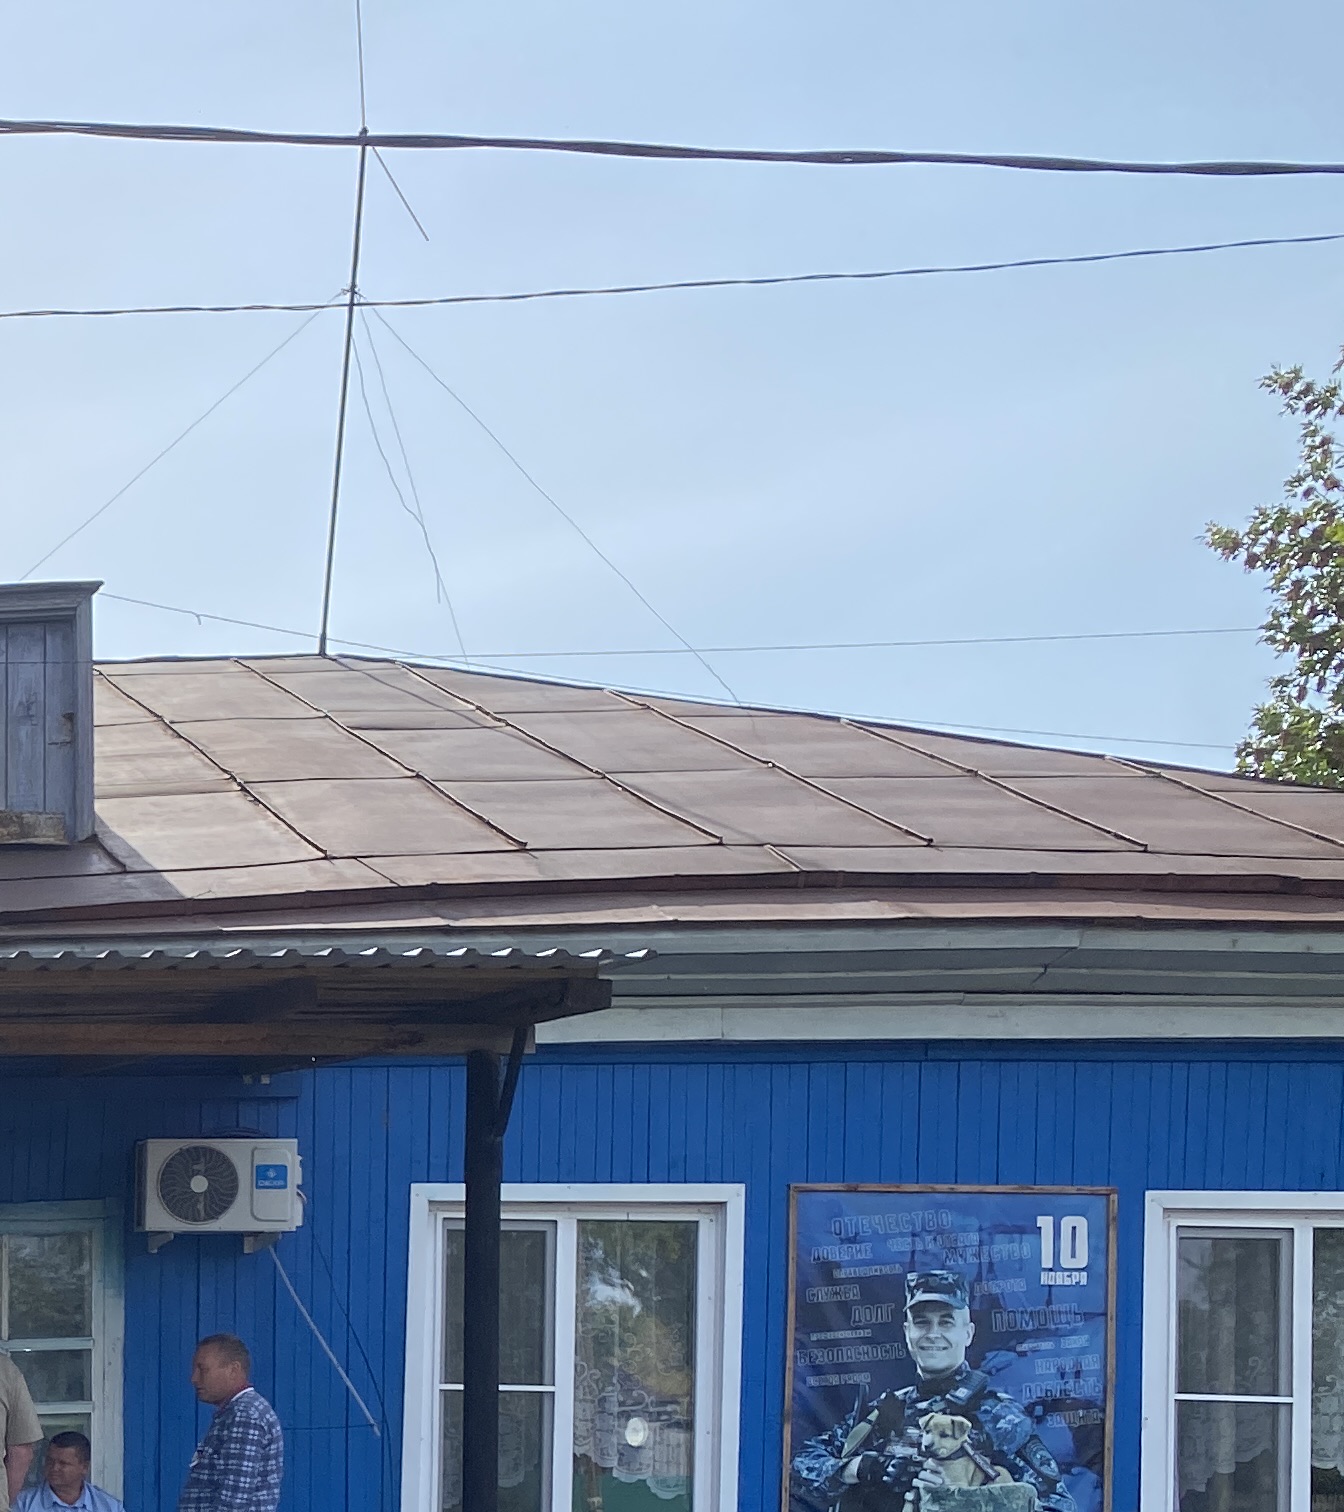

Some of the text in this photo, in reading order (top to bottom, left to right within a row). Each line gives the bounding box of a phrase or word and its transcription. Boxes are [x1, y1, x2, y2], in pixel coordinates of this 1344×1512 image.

[831, 1209, 952, 1238] ОТЕЧЕСТВО
[811, 1243, 873, 1263] ДОВЕРИЕ
[942, 1242, 1031, 1265] МУЖЕСТВО
[1036, 1215, 1088, 1269] 10
[1040, 1271, 1088, 1285] НОЯБРЯ
[806, 1284, 861, 1303] СЛУЖБА
[850, 1303, 895, 1327] ДОЛГ
[992, 1303, 1084, 1332] ПОМОЩЬ
[797, 1342, 907, 1366] БЕЗОПАСНОСТЬ
[1022, 1377, 1103, 1402] ДОБЛЕСТЬ
